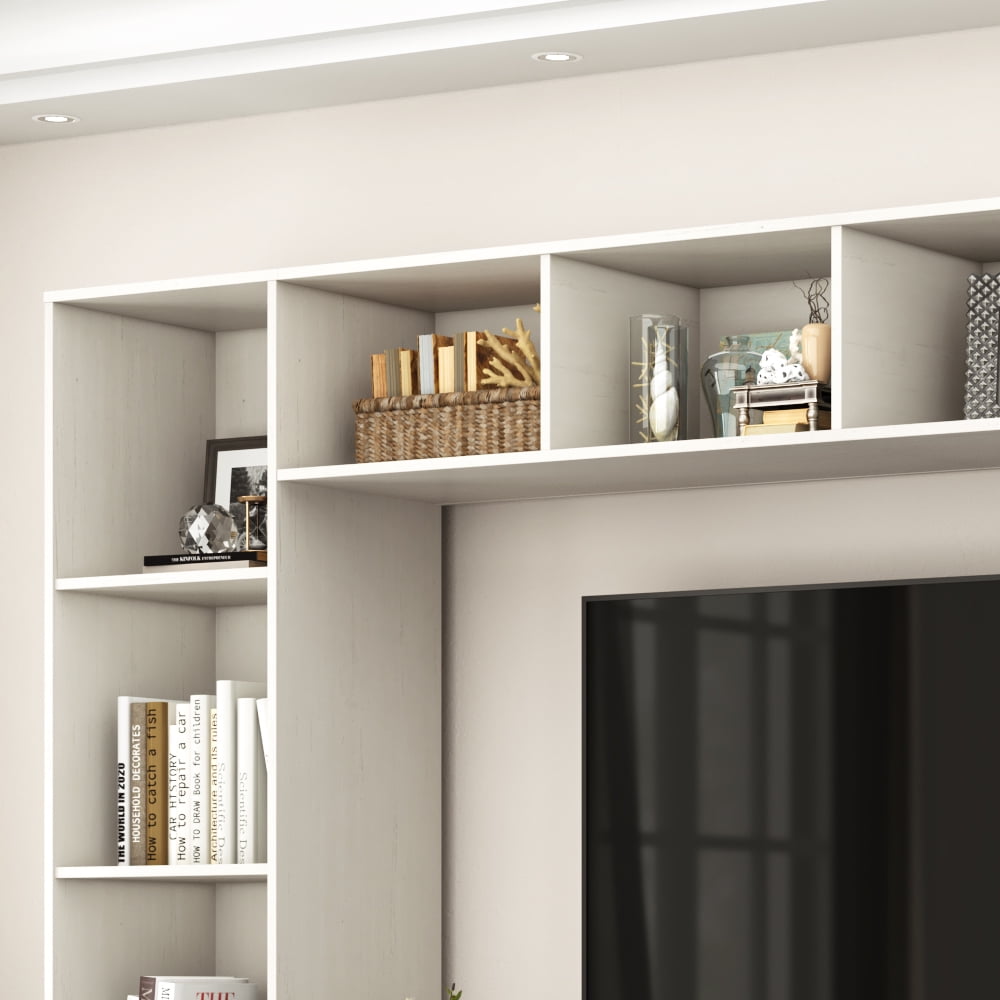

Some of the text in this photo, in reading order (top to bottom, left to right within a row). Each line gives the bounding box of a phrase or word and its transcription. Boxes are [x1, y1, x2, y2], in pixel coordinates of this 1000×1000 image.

[192, 699, 201, 744] children
[179, 742, 186, 750] a
[132, 724, 141, 843] HOUSEHOLD DECORATES
[146, 708, 156, 861] How to catch a fish
[177, 759, 189, 804] repair
[193, 772, 201, 795] Book
[178, 813, 186, 827] to
[193, 800, 201, 823] DRAW
[193, 829, 201, 839] TO
[177, 836, 186, 861] How
[193, 845, 201, 863] HOW
